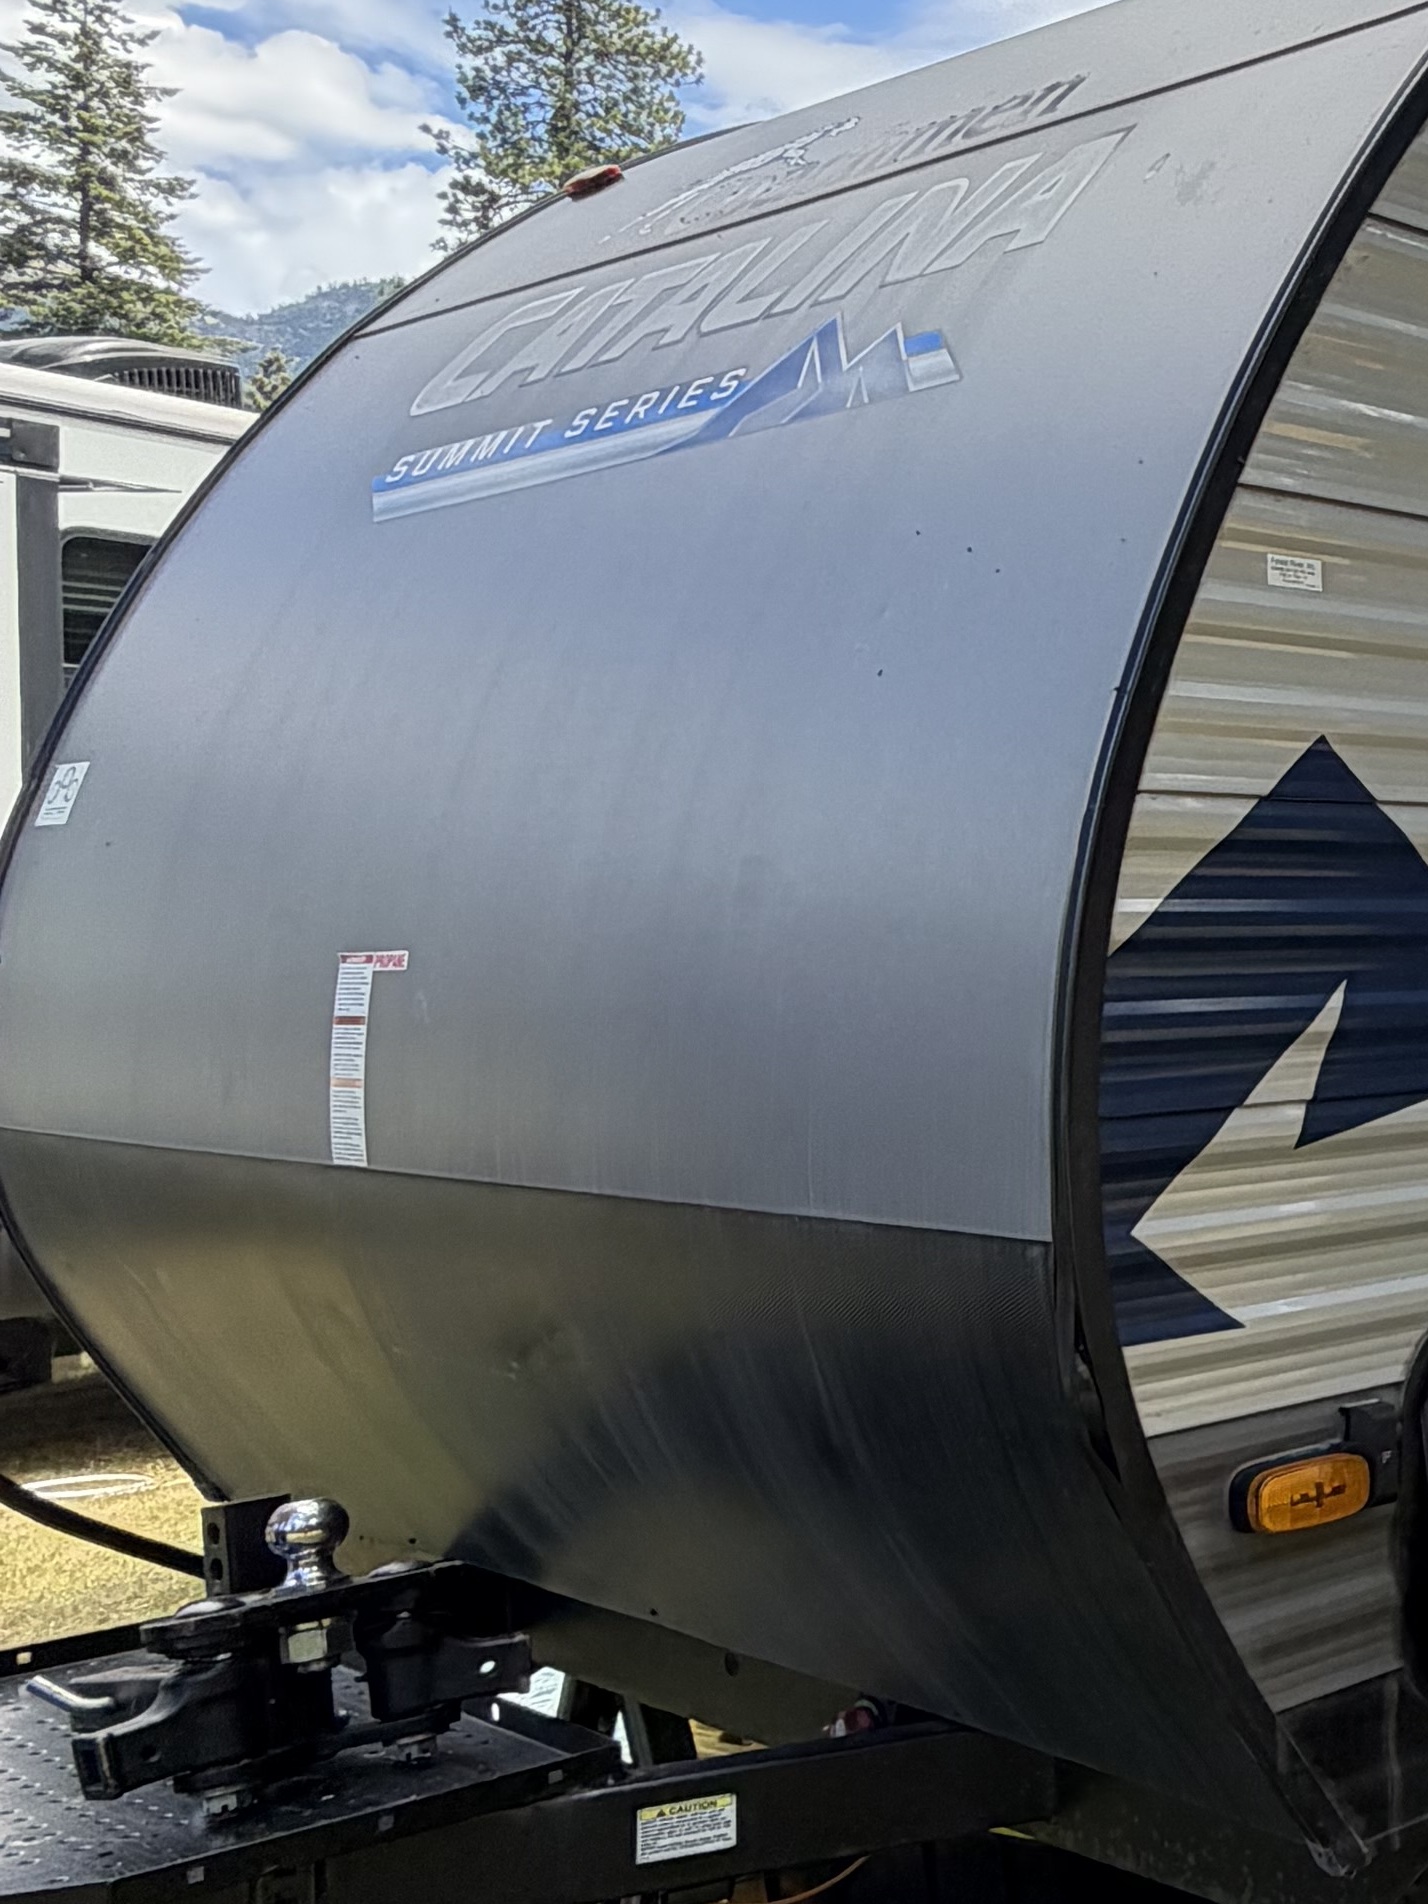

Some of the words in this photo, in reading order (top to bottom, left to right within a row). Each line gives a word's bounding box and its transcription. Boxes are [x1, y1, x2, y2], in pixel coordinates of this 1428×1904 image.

[410, 123, 1137, 416] CATALINA
[384, 418, 554, 483] SUMMIT
[563, 367, 750, 438] SERIES
[668, 1799, 718, 1815] CAUTION
